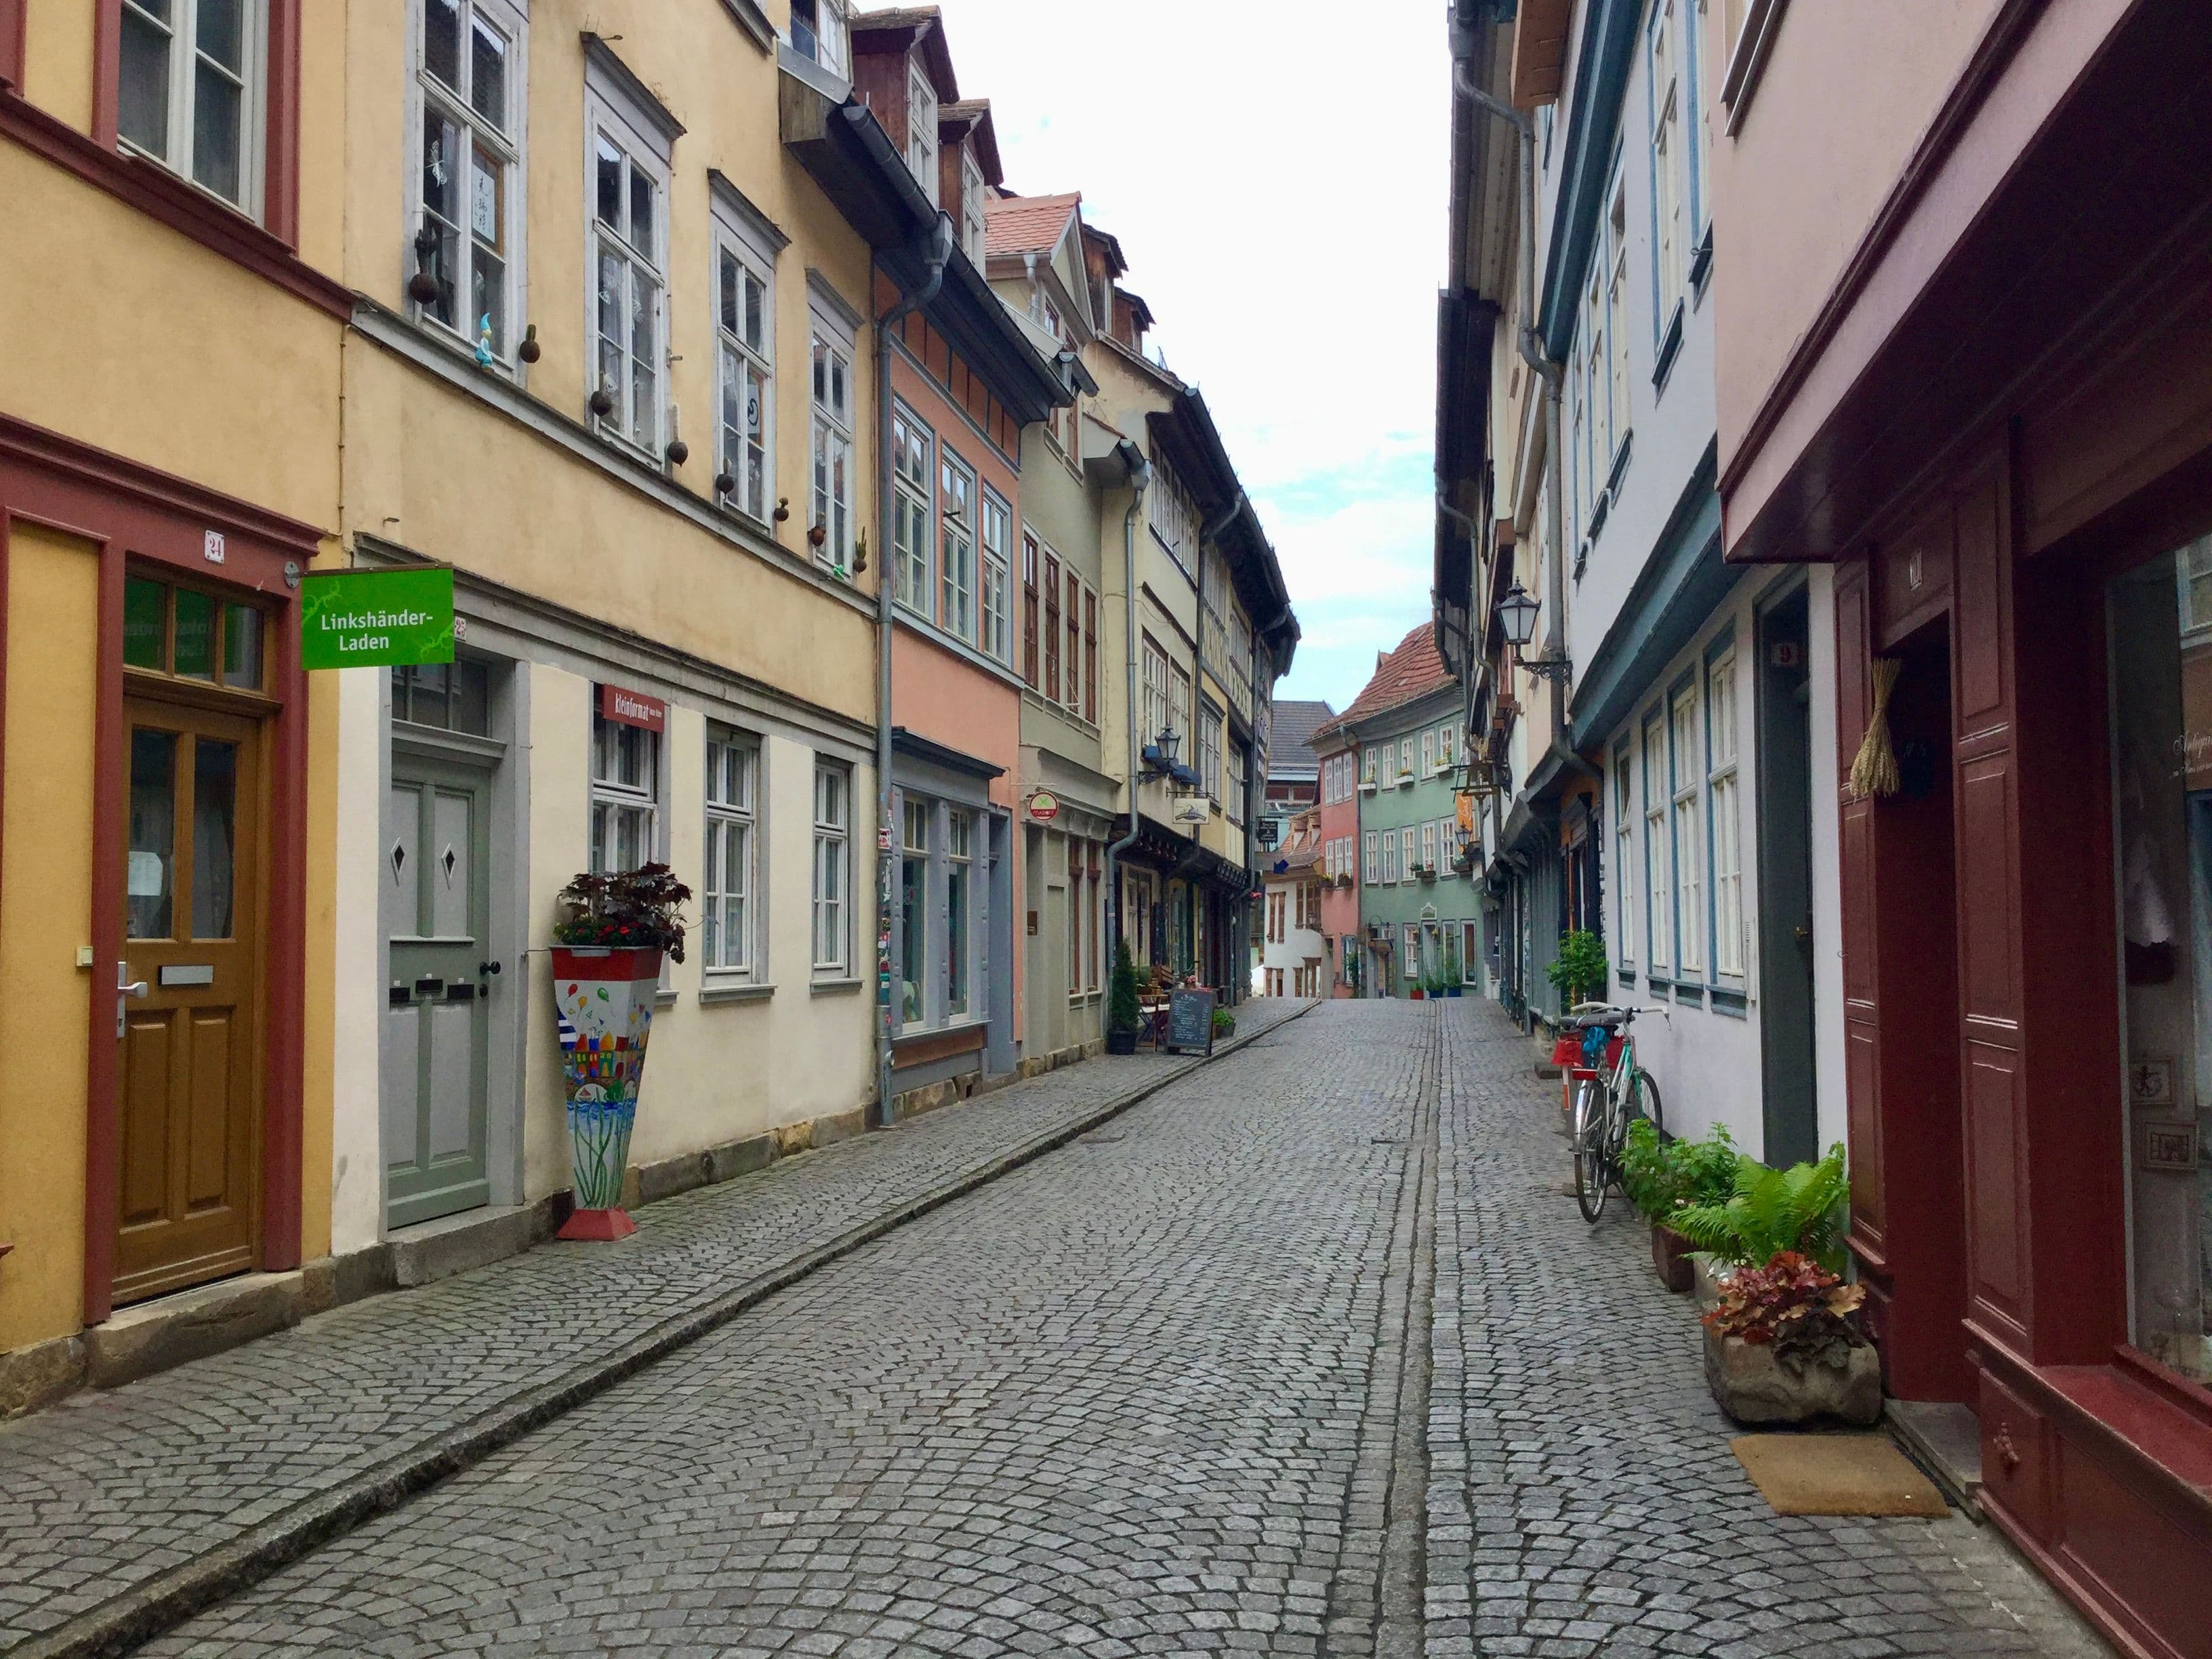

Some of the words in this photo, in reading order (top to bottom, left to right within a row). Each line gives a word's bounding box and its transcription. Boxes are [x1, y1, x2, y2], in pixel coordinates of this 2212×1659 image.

[209, 537, 222, 556] 24
[321, 609, 434, 631] Linkshänder-
[455, 619, 466, 637] 25
[339, 633, 390, 651] Laden
[1780, 645, 1791, 663] 9
[614, 692, 649, 722] kleinformat
